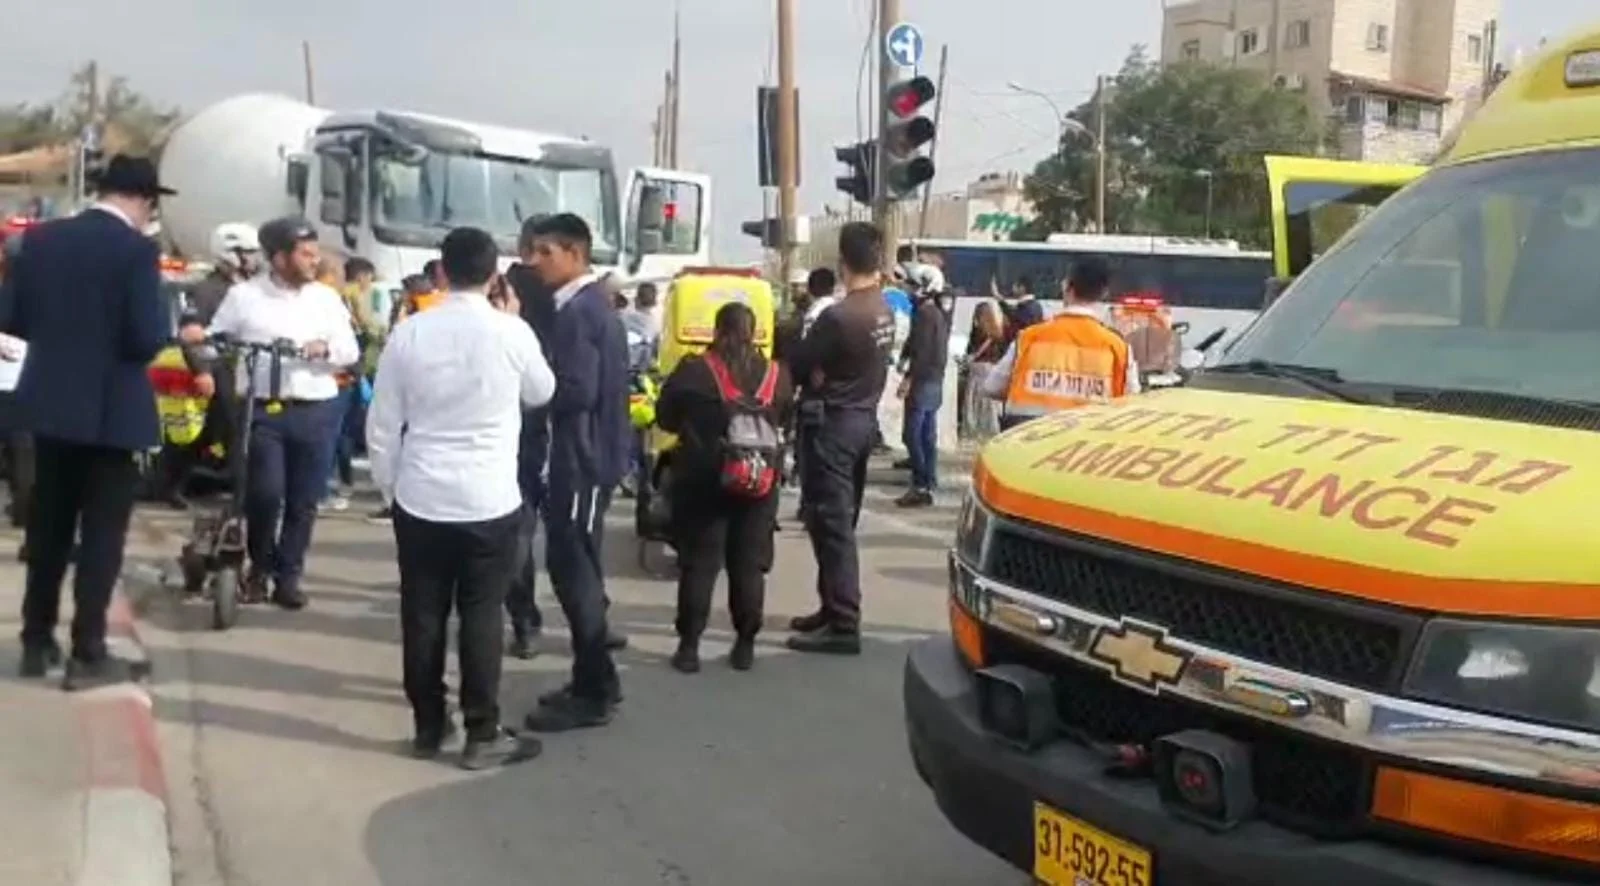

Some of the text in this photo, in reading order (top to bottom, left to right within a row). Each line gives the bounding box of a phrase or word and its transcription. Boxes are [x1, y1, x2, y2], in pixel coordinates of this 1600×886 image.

[1089, 407, 1251, 441] אדום
[1257, 423, 1400, 462] דוד
[1393, 444, 1572, 495] מגן
[1030, 440, 1498, 549] AMBULANCE
